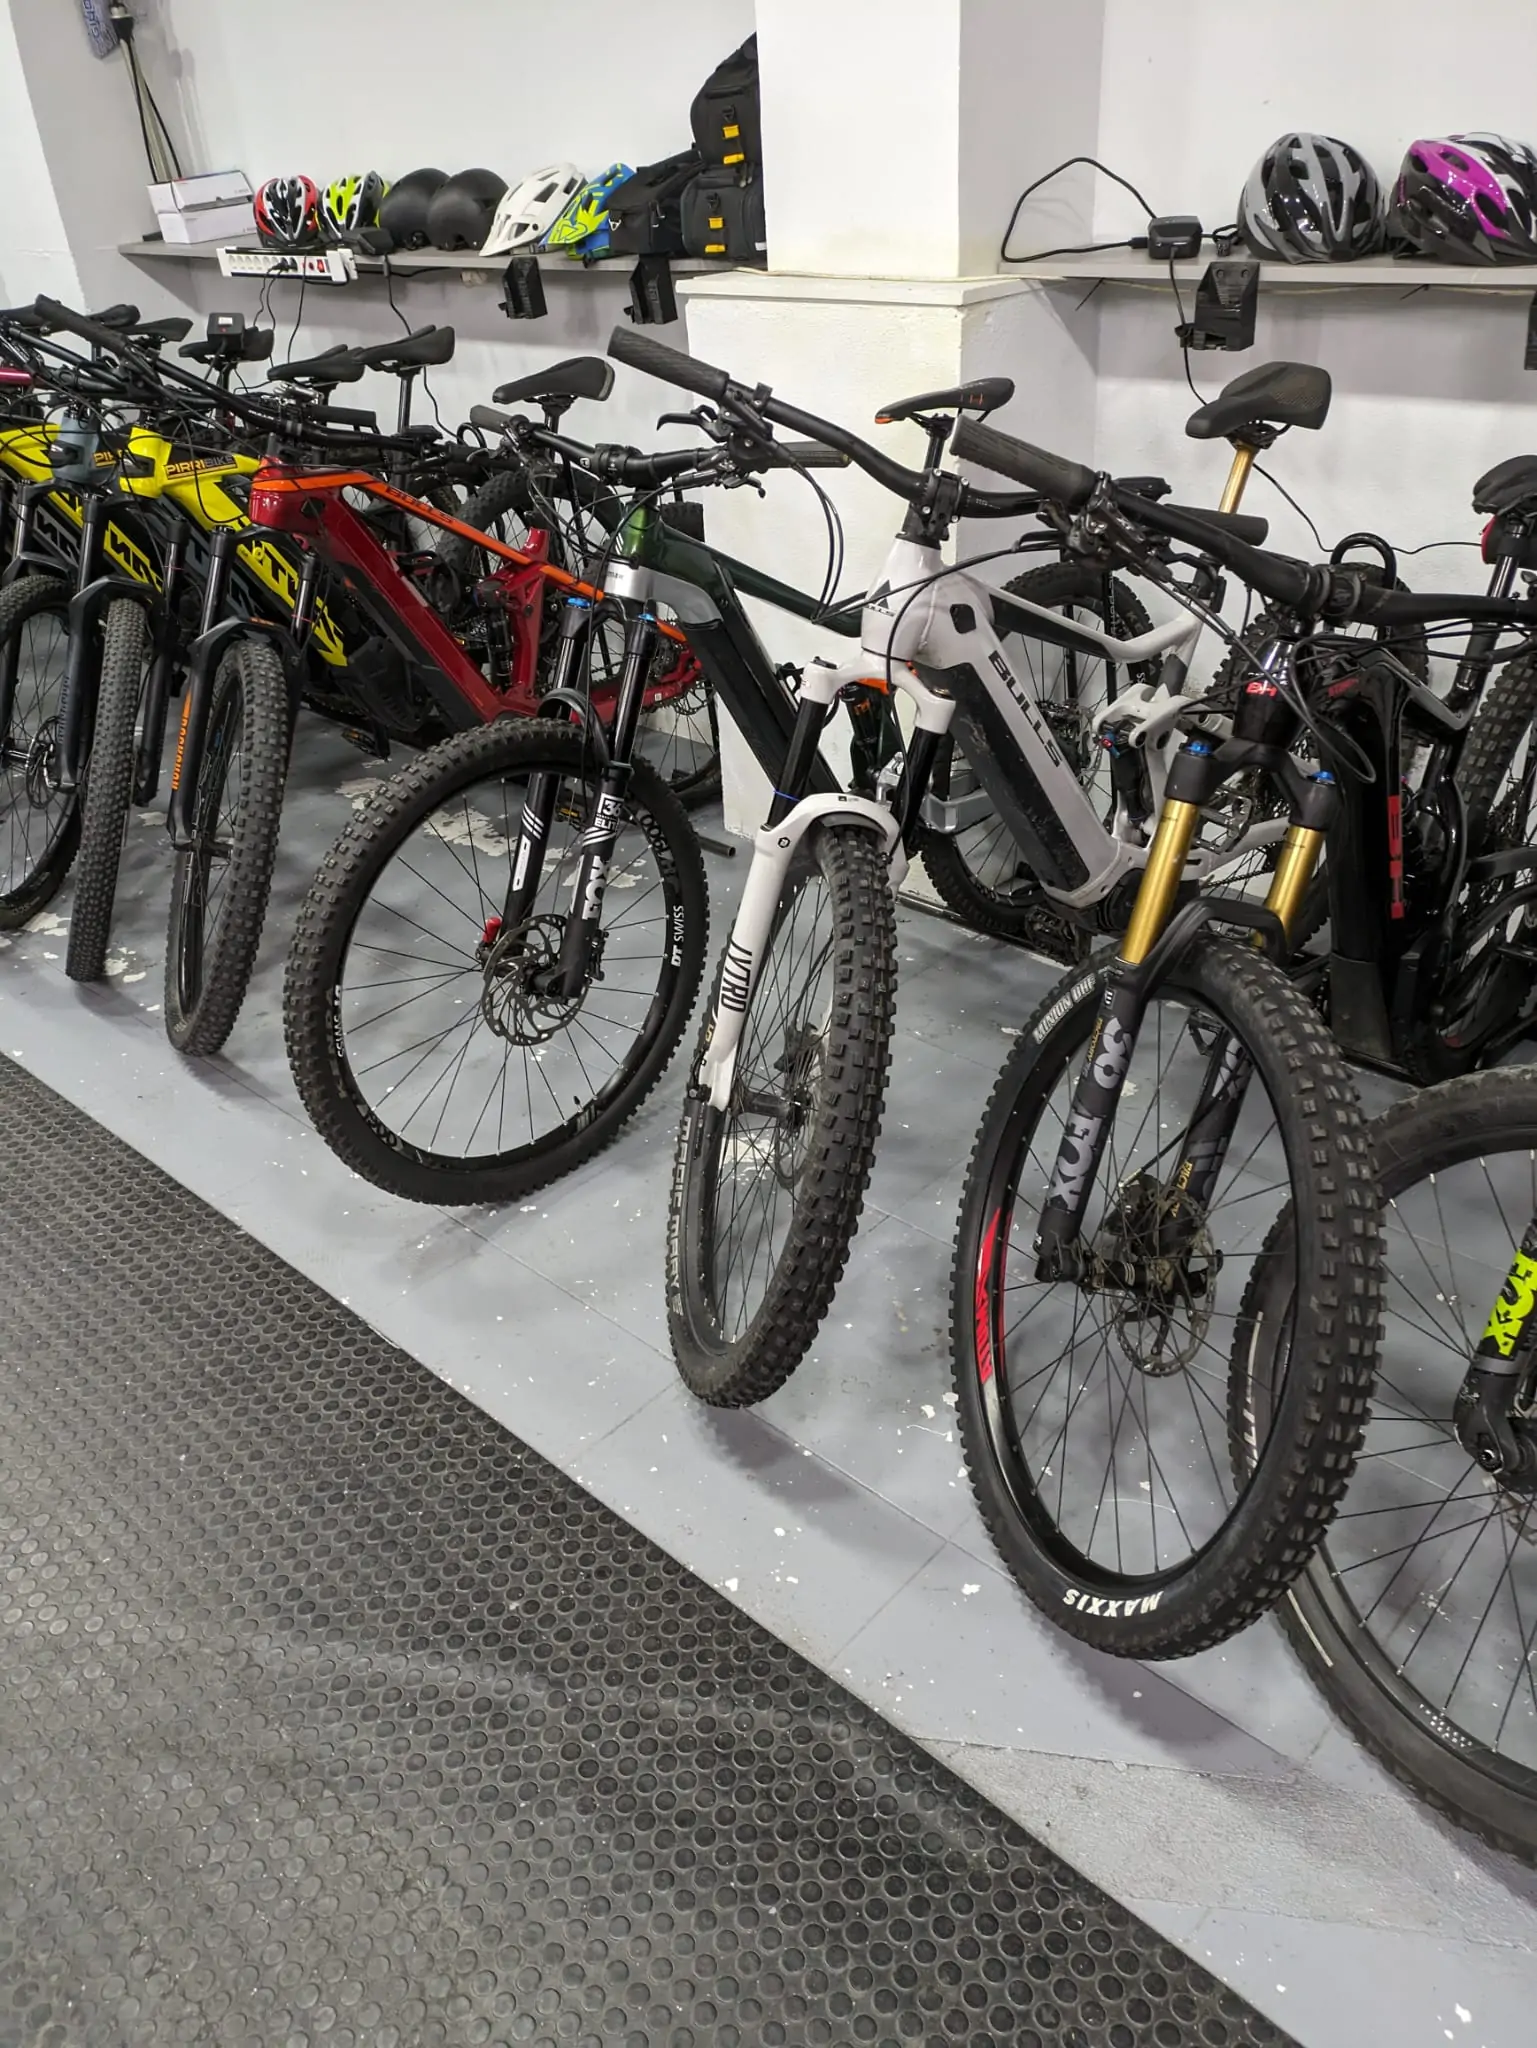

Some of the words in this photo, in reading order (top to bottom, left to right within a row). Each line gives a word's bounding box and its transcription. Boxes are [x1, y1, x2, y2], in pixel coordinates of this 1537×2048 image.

[988, 650, 1062, 767] BULLS
[1246, 680, 1278, 697] BH
[673, 905, 684, 942] SWISS
[671, 945, 683, 967] DT
[1032, 991, 1074, 1045] MINION
[1069, 972, 1096, 1003] DHF
[1048, 1112, 1103, 1212] FOX
[1483, 1249, 1537, 1356] FOX
[1062, 1588, 1164, 1617] MAXXIS
